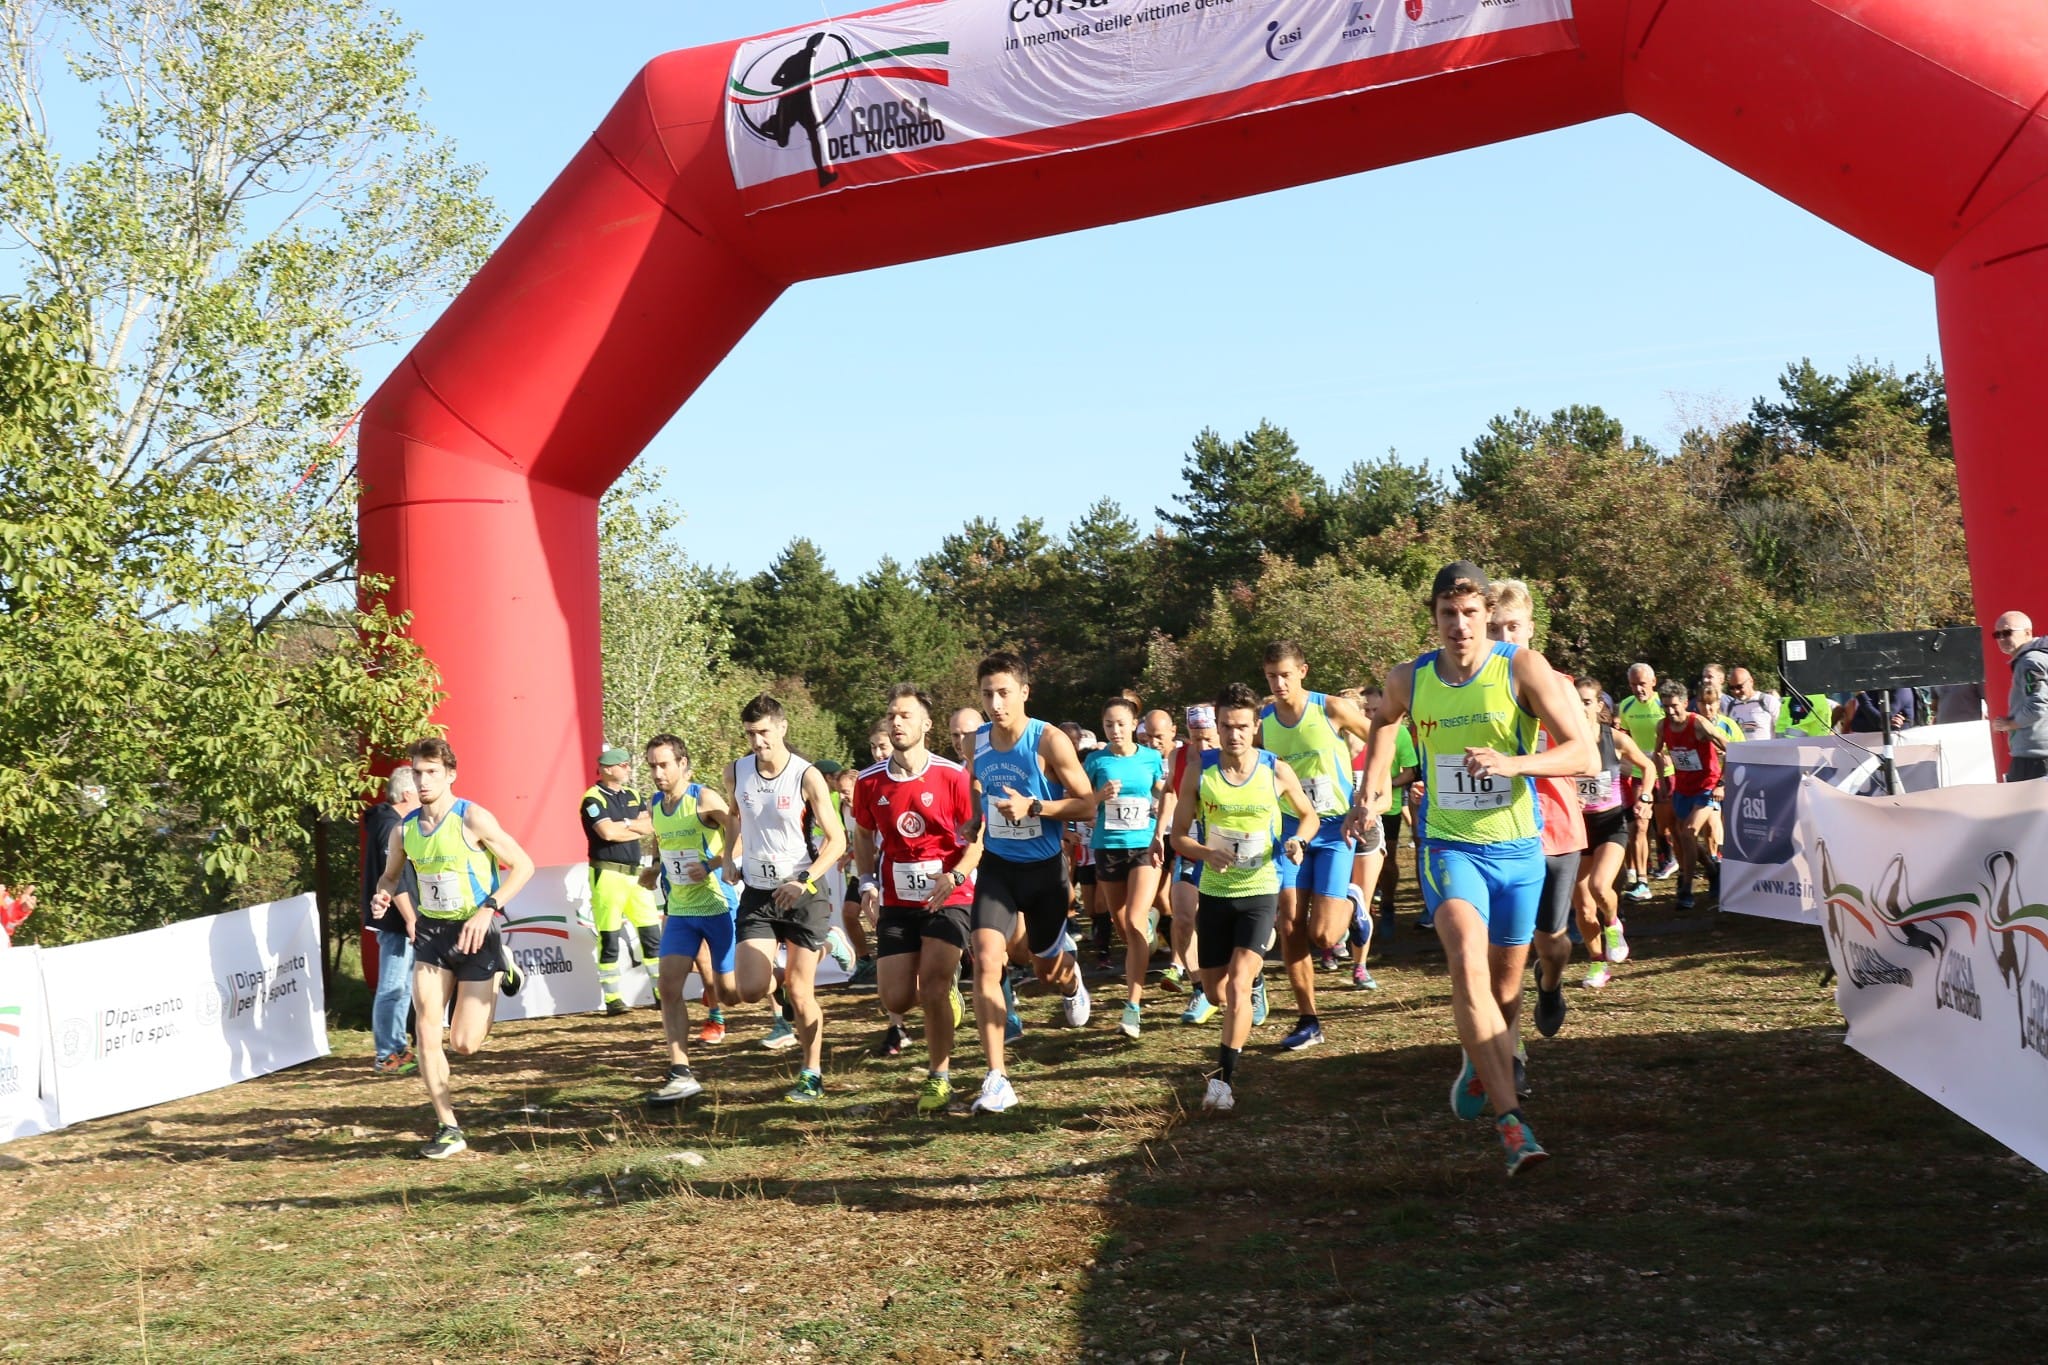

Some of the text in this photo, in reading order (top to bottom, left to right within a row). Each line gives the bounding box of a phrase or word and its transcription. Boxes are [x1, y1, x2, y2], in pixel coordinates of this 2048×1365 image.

[1006, 36, 1019, 50] in
[1023, 24, 1090, 47] memoria
[1094, 14, 1132, 33] delle
[1136, 1, 1190, 23] vittime
[1342, 26, 1376, 39] FIDAL
[1279, 27, 1303, 45] asi
[851, 97, 932, 138] CORSA
[828, 119, 945, 160] DEL RICORDO
[1455, 771, 1493, 792] 116
[1580, 782, 1597, 795] 26
[1116, 806, 1140, 820] 127
[1743, 790, 1768, 820] asi
[673, 861, 681, 874] 3
[761, 864, 777, 879] 13
[907, 874, 926, 889] 35
[431, 885, 441, 900] 2
[528, 960, 573, 976] RICORDO
[269, 978, 298, 1003] sport
[105, 997, 184, 1029] Dipamento
[105, 1021, 180, 1057] per lo spo
